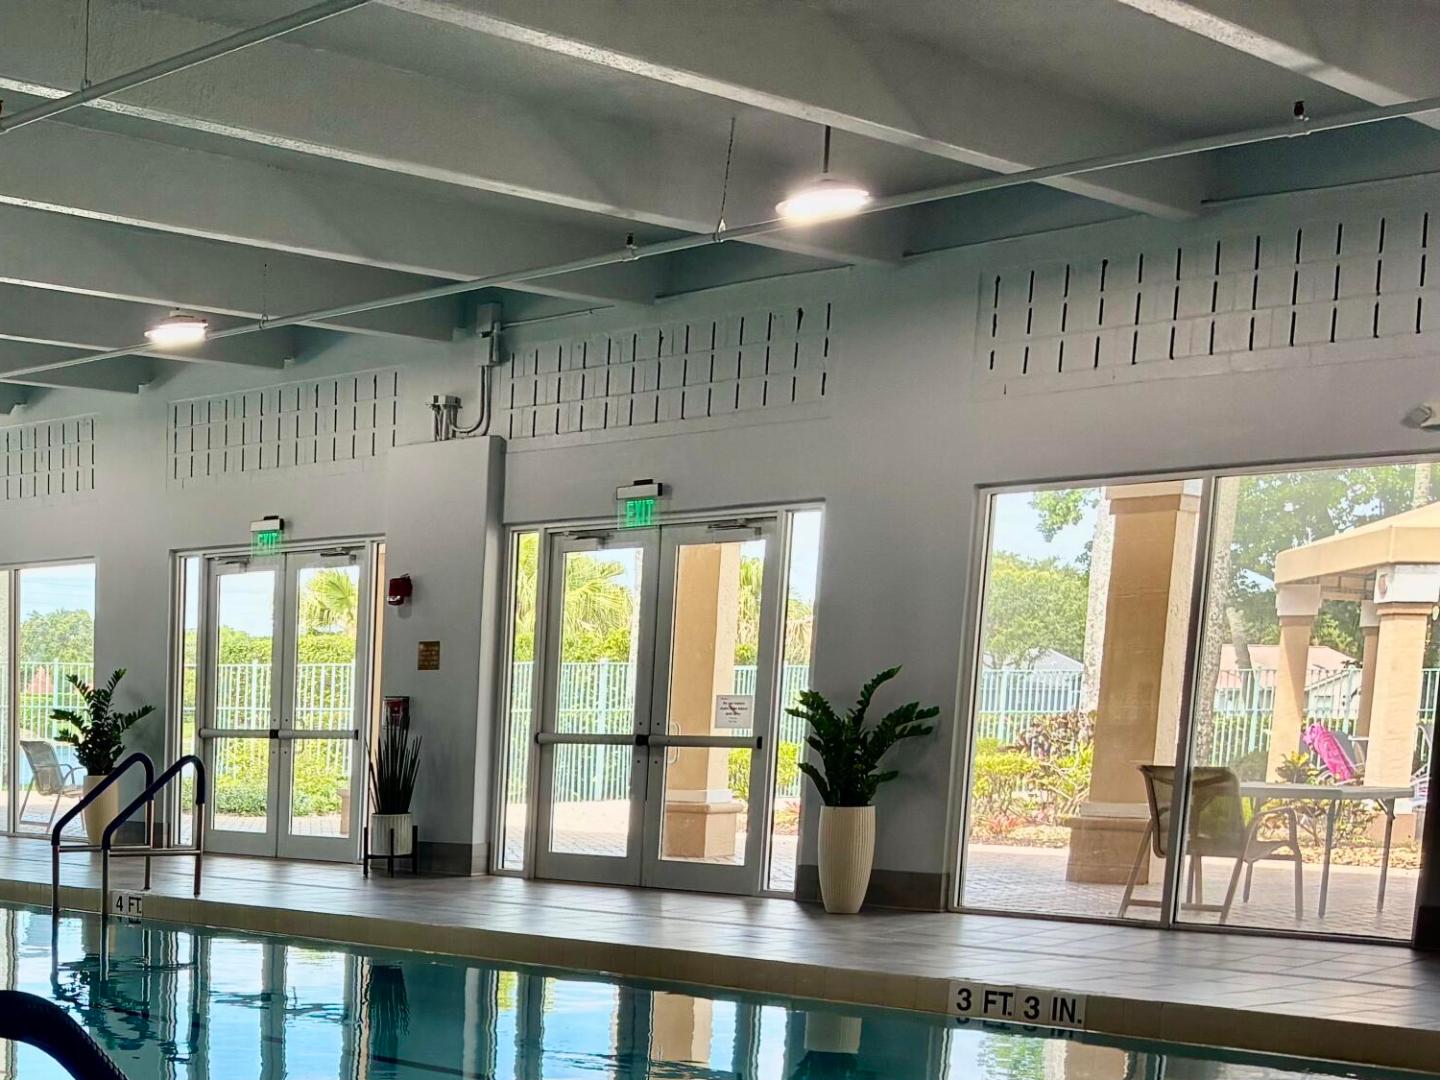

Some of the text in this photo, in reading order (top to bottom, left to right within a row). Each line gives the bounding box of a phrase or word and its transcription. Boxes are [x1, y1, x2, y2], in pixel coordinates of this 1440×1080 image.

[625, 499, 654, 526] EXIT
[257, 533, 278, 552] EXIT
[116, 896, 123, 911] 4
[956, 988, 1082, 1024] 3 FT. 3 IN.
